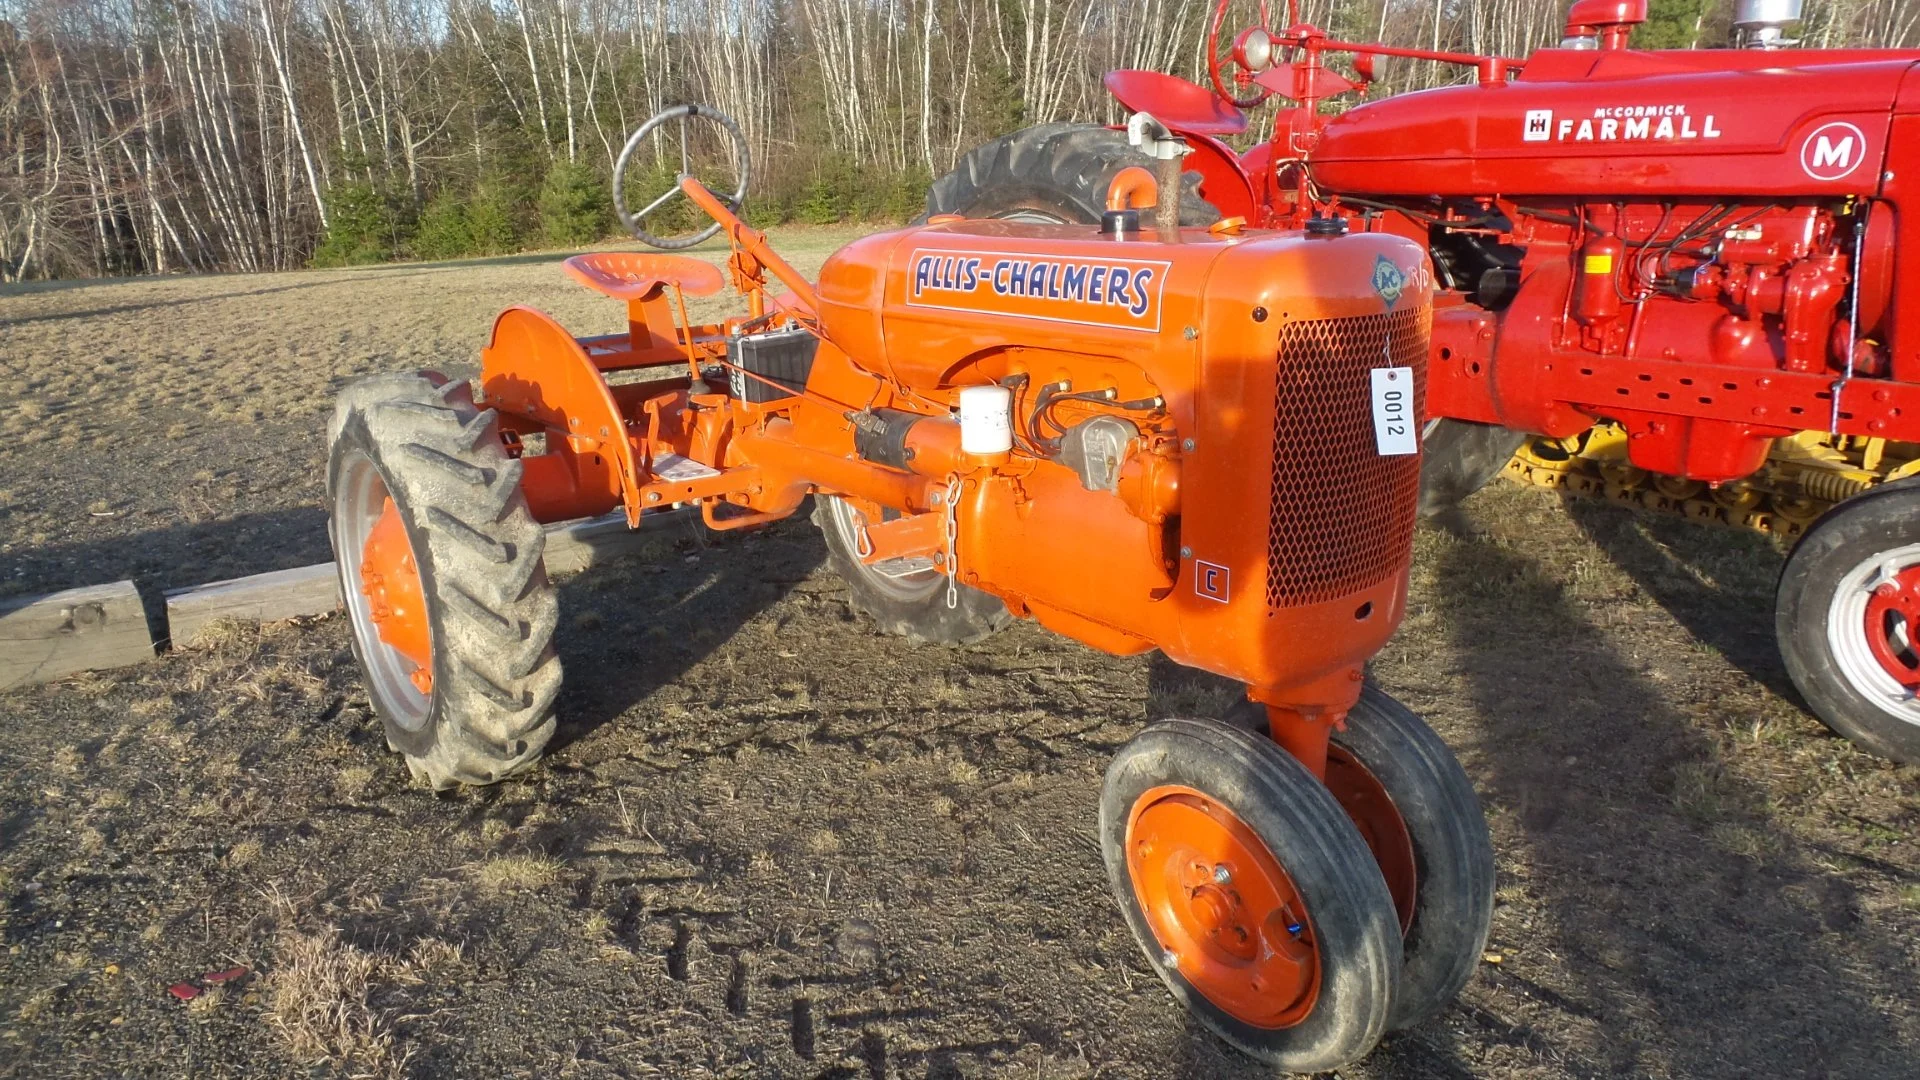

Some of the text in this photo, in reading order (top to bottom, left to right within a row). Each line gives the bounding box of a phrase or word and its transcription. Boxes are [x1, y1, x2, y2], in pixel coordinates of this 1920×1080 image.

[1558, 115, 1721, 141] FARMALL
[1812, 135, 1854, 168] M
[914, 255, 1154, 318] ALLIS-CHALMERS
[1384, 391, 1405, 436] 0012
[1206, 569, 1218, 592] C
